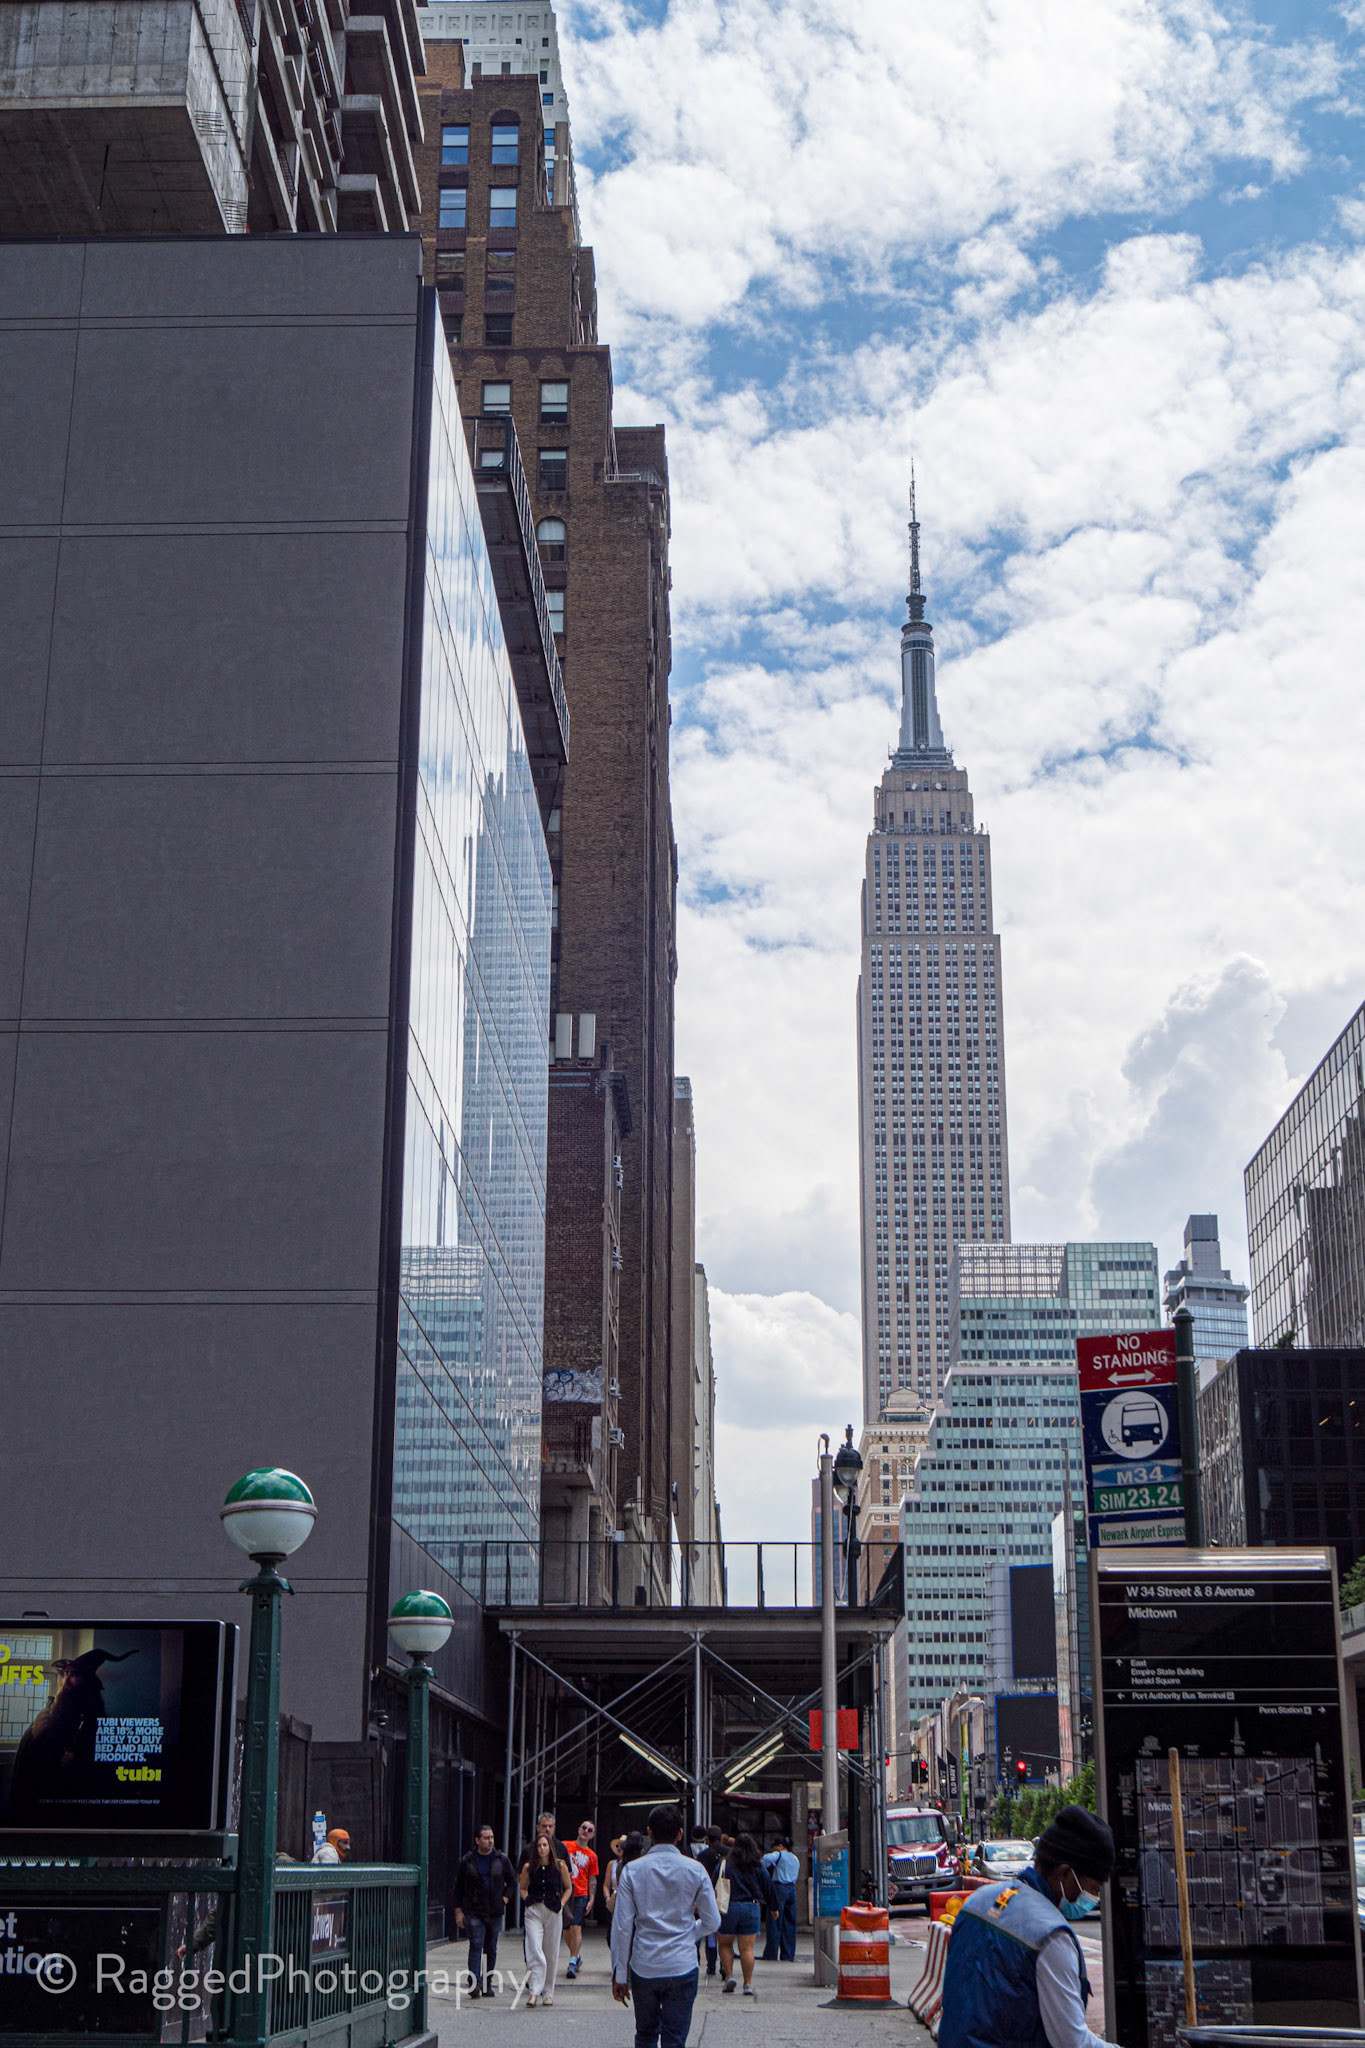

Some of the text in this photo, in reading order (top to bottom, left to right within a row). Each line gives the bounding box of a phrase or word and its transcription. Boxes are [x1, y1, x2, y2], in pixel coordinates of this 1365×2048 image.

[1116, 1335, 1141, 1351] NO
[1092, 1350, 1168, 1370] STANDING
[1116, 1466, 1164, 1486] M34
[1100, 1523, 1187, 1542] Newark Airport Express
[1126, 1585, 1256, 1597] W 34 Street & 8 Avenue
[1128, 1607, 1178, 1619] Midtown
[1131, 1668, 1156, 1677] Empire
[1176, 1668, 1205, 1677] Building
[1131, 1677, 1181, 1686] Herald Square
[1131, 1692, 1226, 1702] Port Authority Bus Terminal
[1259, 1706, 1304, 1714] Penn Station
[97, 1718, 160, 1727] TUBI VIEWERS
[96, 1727, 164, 1736] ARE 18% MORE
[96, 1735, 162, 1744] LIKELY TO BUY
[95, 1744, 163, 1753] BED AND BATH
[94, 1753, 147, 1762] PRODUCTS.
[949, 1764, 957, 1781] NAVY
